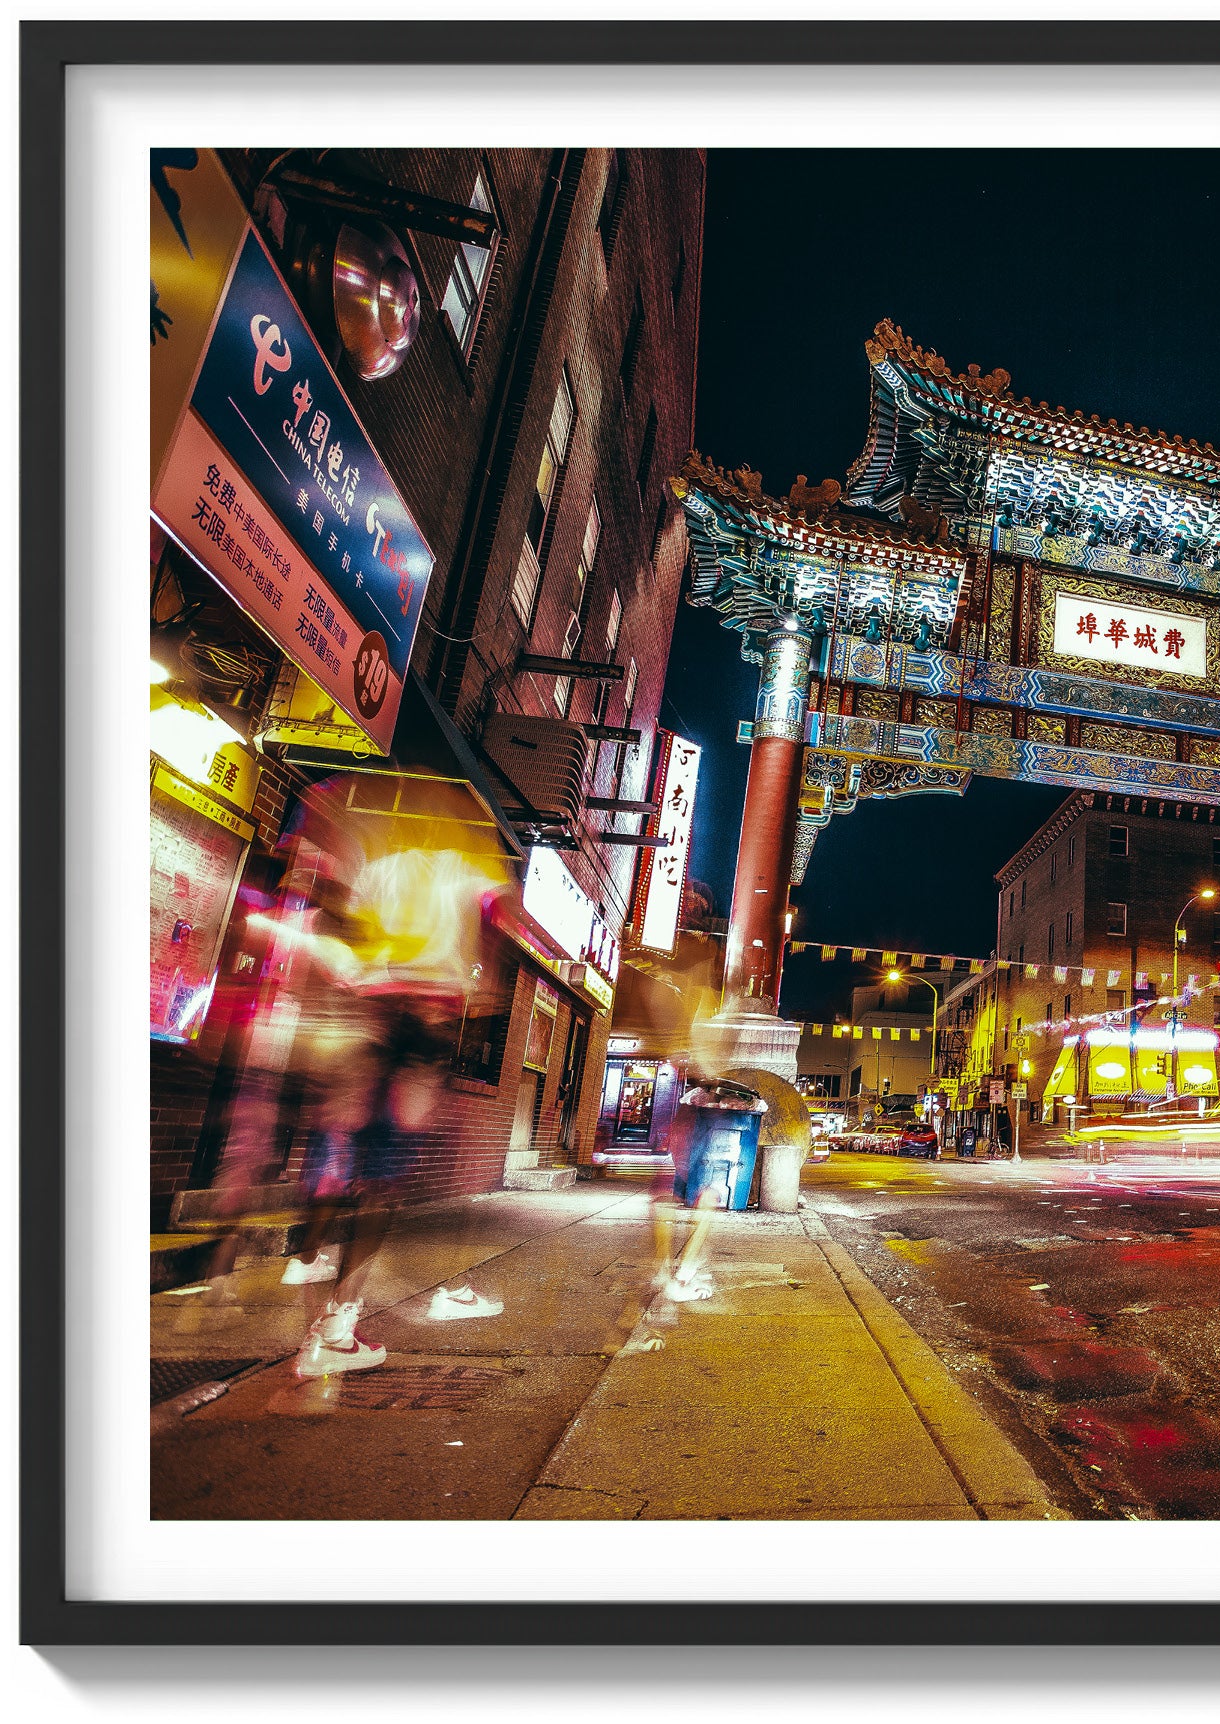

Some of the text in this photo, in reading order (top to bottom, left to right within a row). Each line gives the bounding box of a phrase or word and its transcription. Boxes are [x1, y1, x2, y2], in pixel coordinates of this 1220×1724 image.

[203, 463, 292, 583] 免费中美国际长途
[282, 419, 351, 527] CHINA TELECOM
[191, 496, 285, 612] 无限美国本地通话
[296, 488, 364, 589] 美国手机卡
[358, 649, 387, 703] $19
[657, 743, 696, 887] 河南小吃
